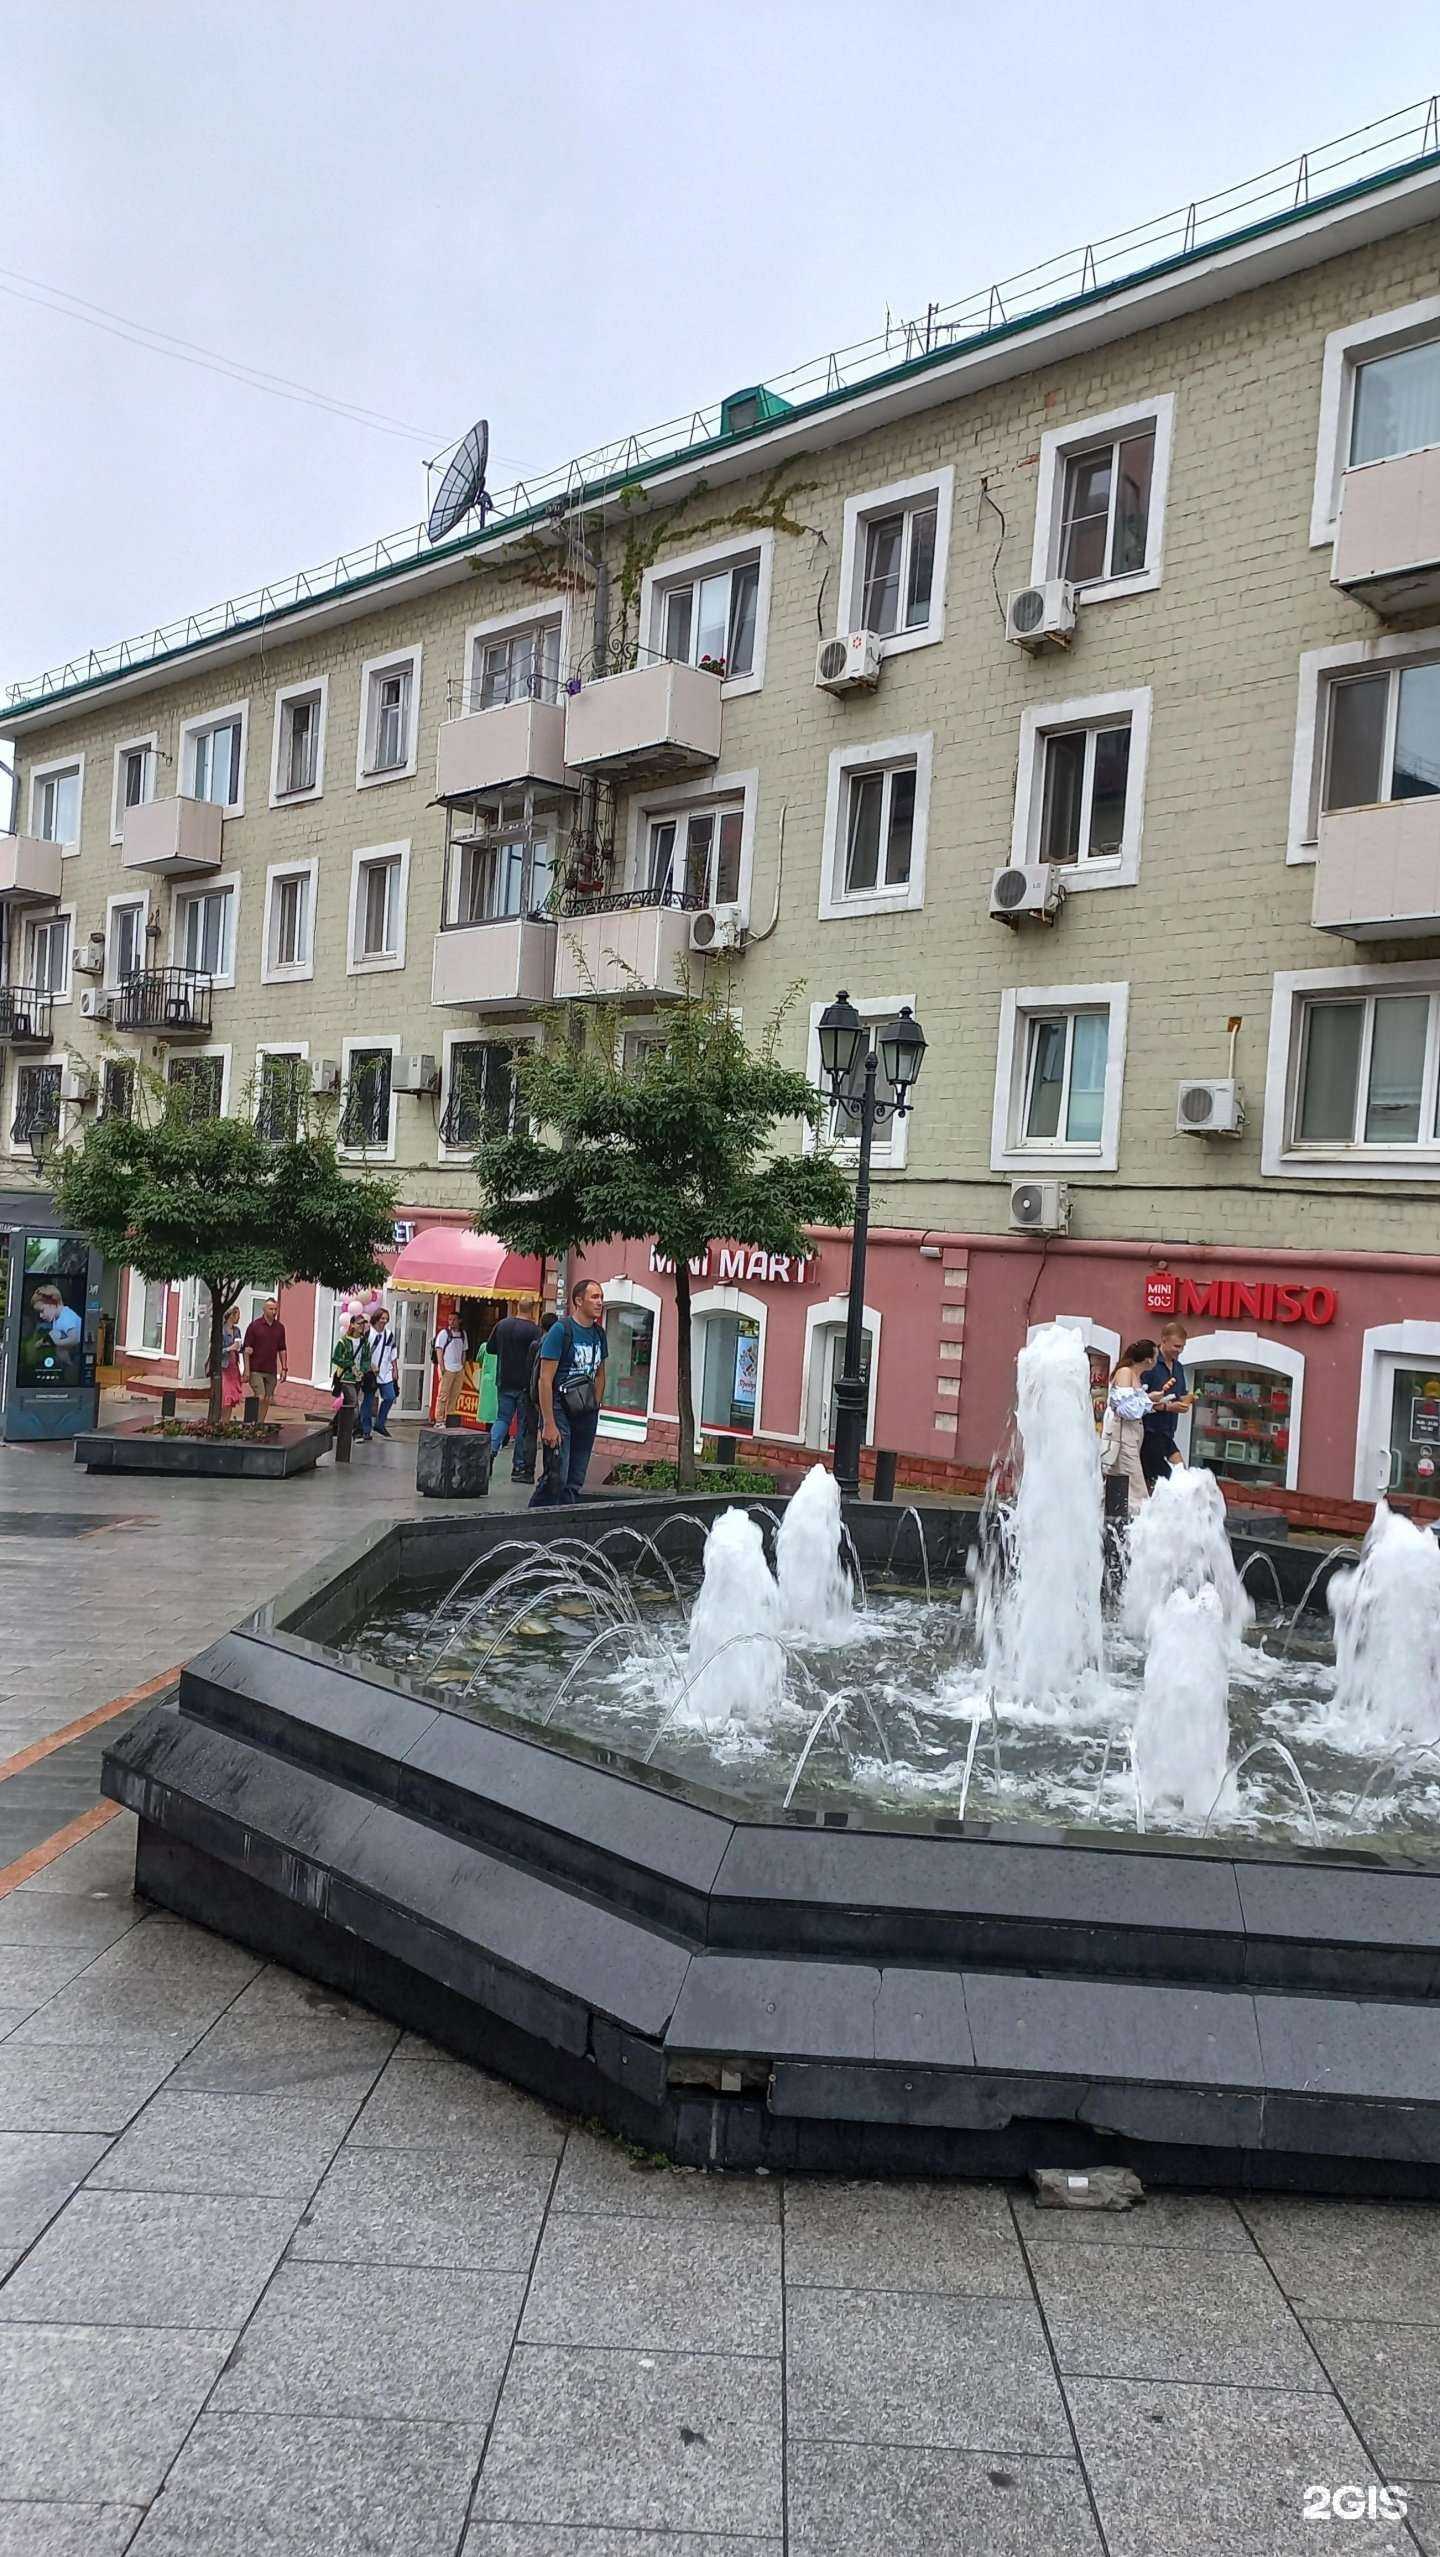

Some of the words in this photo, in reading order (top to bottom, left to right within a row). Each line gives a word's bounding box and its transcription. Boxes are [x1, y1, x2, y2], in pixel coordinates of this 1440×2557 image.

[719, 1249, 813, 1283] MART
[1147, 1284, 1171, 1294] MINI
[1182, 1278, 1336, 1325] MINISO
